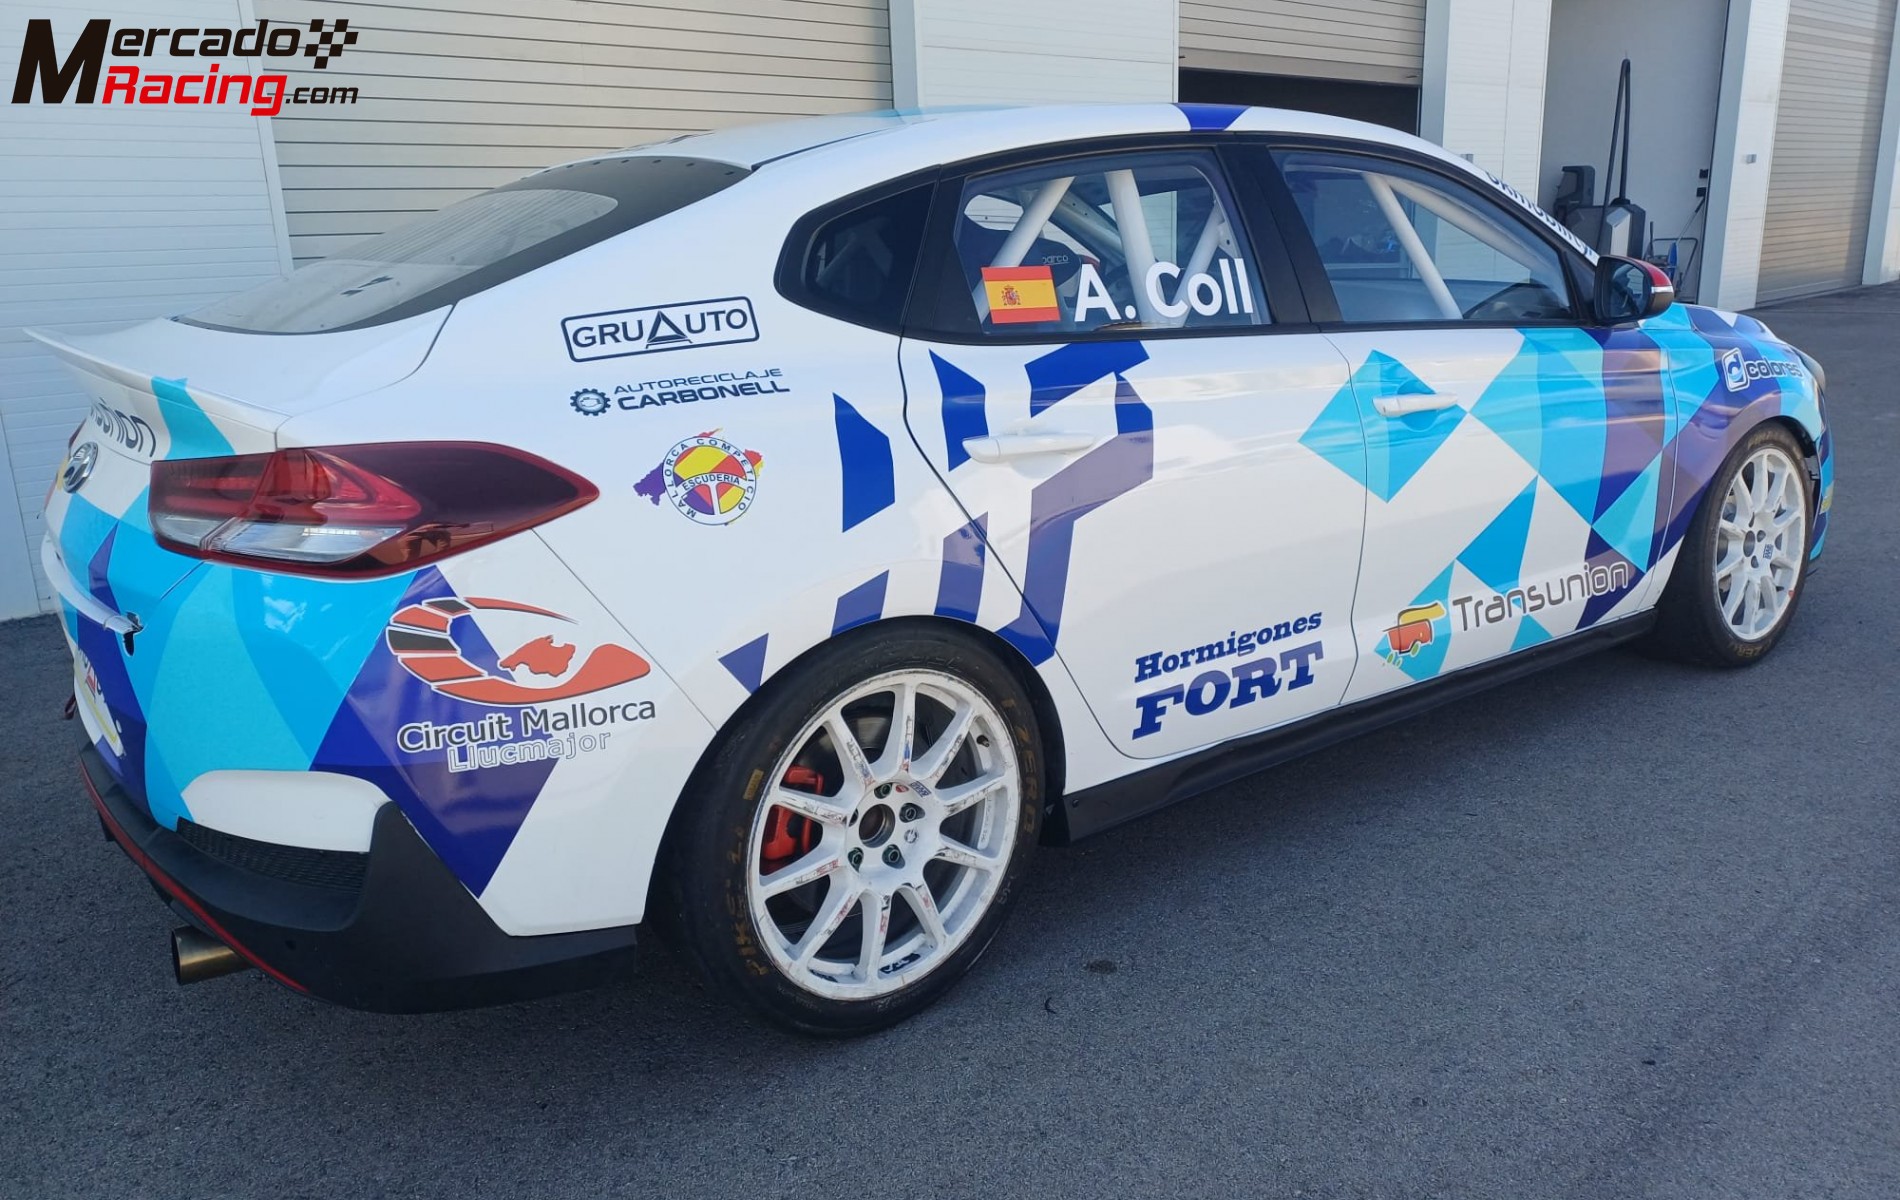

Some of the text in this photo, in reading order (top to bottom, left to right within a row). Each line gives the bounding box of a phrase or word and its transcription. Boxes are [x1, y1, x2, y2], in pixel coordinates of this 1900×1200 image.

[1074, 258, 1254, 322] A. Coll
[614, 368, 784, 394] AUTORECICLAJE
[617, 380, 791, 411] CARBONELL
[664, 438, 754, 518] MALLORCA COMPETICIO
[682, 474, 740, 491] ESCUDERIA
[1452, 562, 1629, 632] Transunion
[1133, 611, 1323, 683] Hormigones
[1131, 641, 1324, 740] FORT
[398, 700, 656, 752] Circuit Mallorca
[448, 731, 611, 772] Llucmajor
